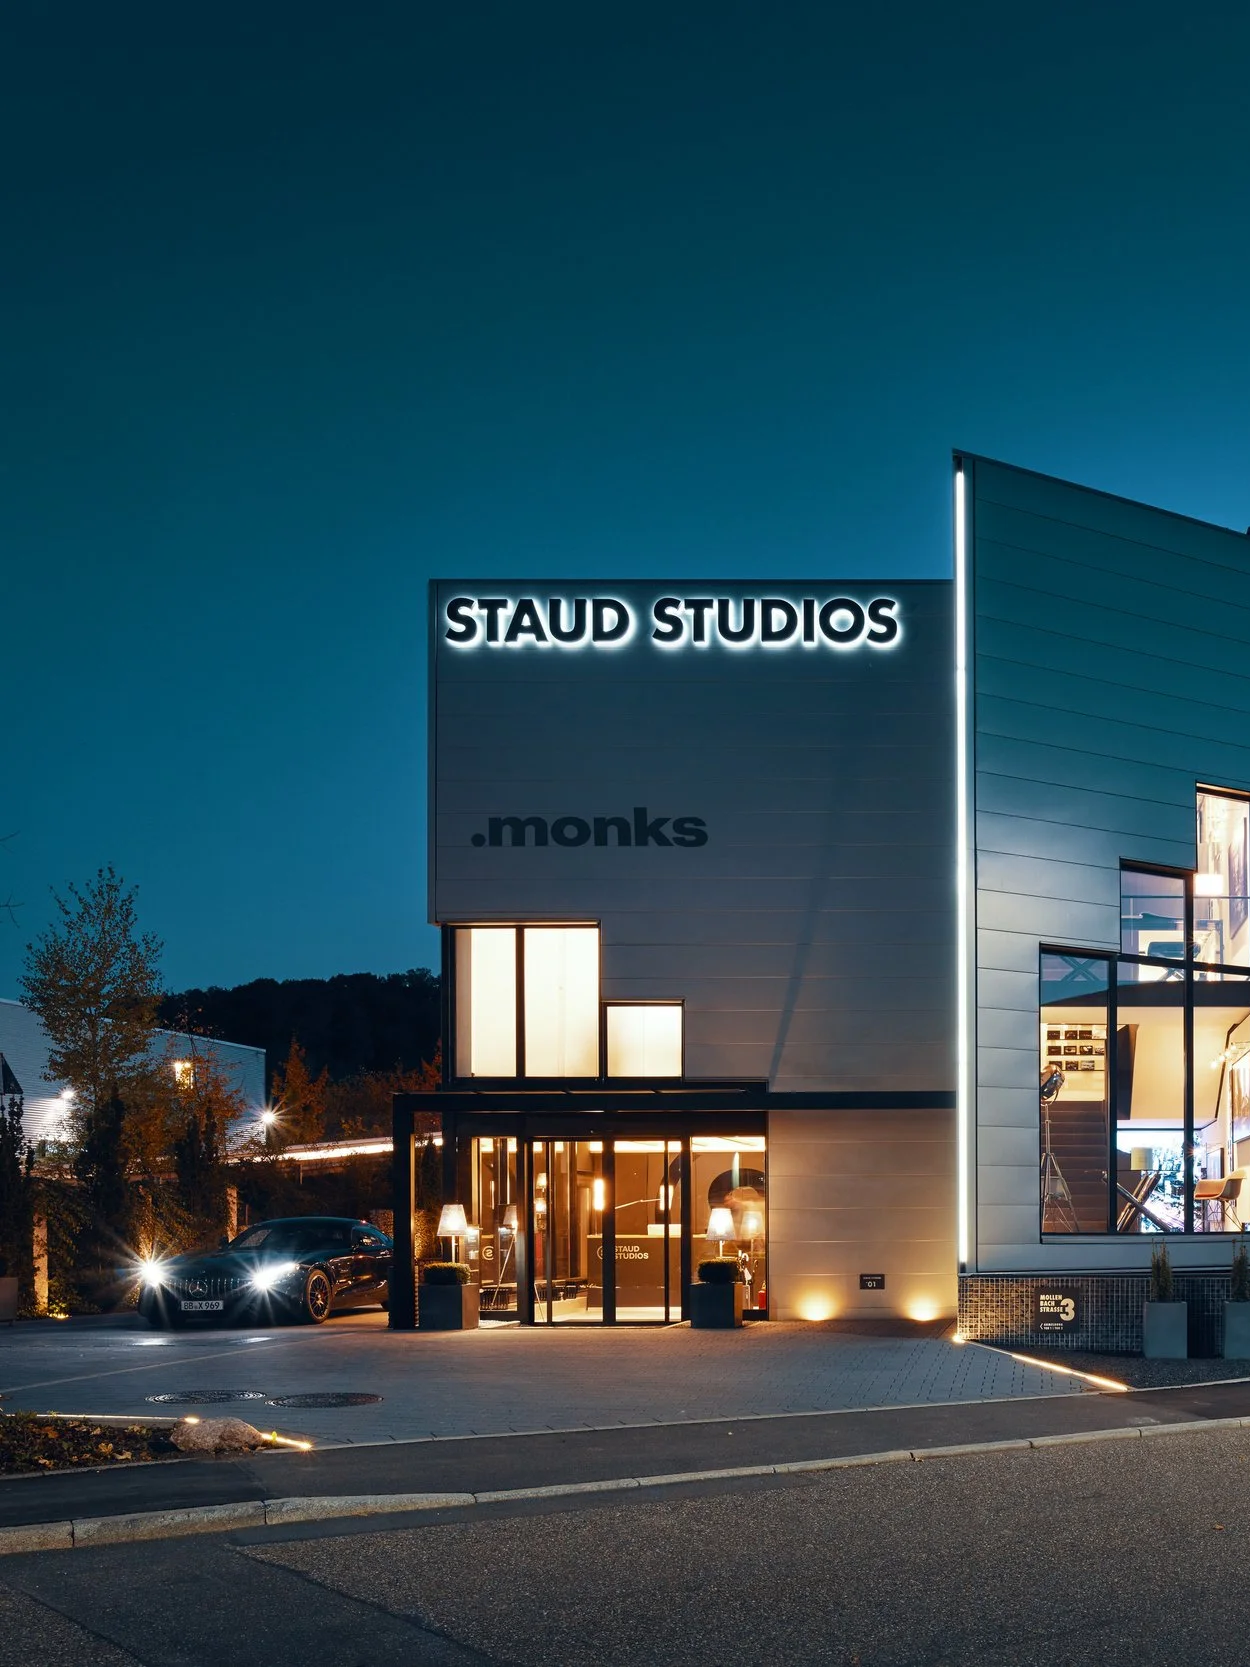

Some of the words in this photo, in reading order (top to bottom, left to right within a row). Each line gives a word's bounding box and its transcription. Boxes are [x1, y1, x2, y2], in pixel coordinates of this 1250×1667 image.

[445, 597, 630, 643] STAUD
[651, 597, 898, 643] STUDIOS
[471, 807, 708, 848] .monks
[198, 1302, 204, 1310] X
[204, 1302, 220, 1310] 969
[1060, 1298, 1075, 1321] 3
